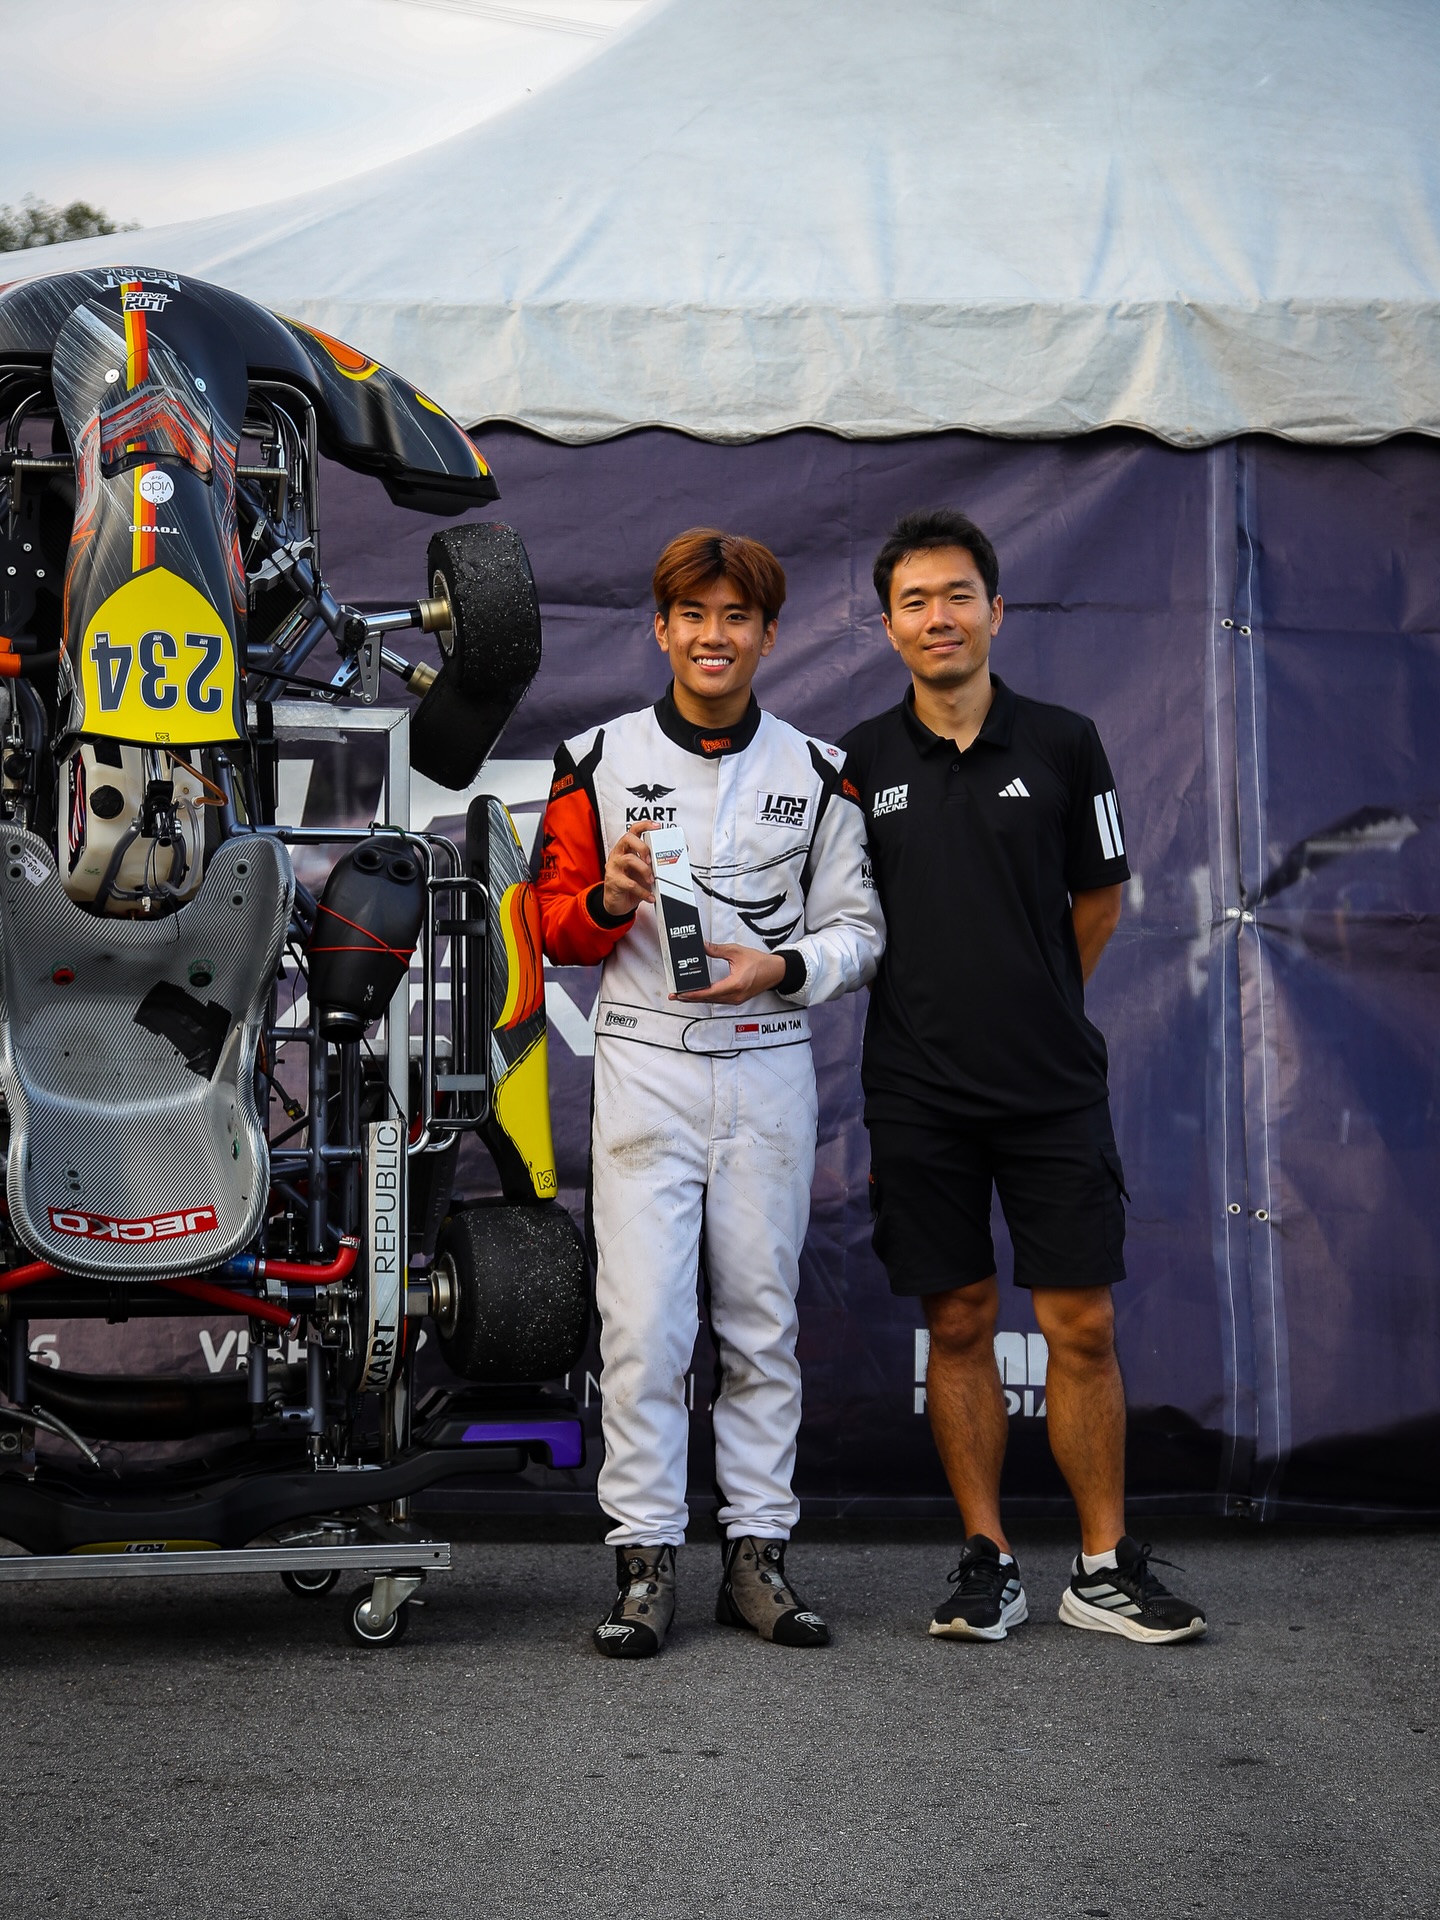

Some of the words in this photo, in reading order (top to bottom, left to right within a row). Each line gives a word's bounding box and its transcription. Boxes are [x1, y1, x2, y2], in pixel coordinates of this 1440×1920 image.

[142, 481, 173, 495] vida
[129, 525, 180, 534] TOYO-G
[89, 630, 223, 714] 234
[625, 806, 677, 822] KART
[873, 801, 909, 819] RACING
[760, 814, 805, 826] RACING
[677, 956, 699, 969] 3RD
[604, 1010, 638, 1029] freem
[761, 1021, 787, 1034] DILLAN
[788, 1019, 802, 1030] TAN
[373, 1126, 398, 1274] REPUBLIC
[52, 1210, 213, 1240] JECKO
[367, 1319, 395, 1387] KART
